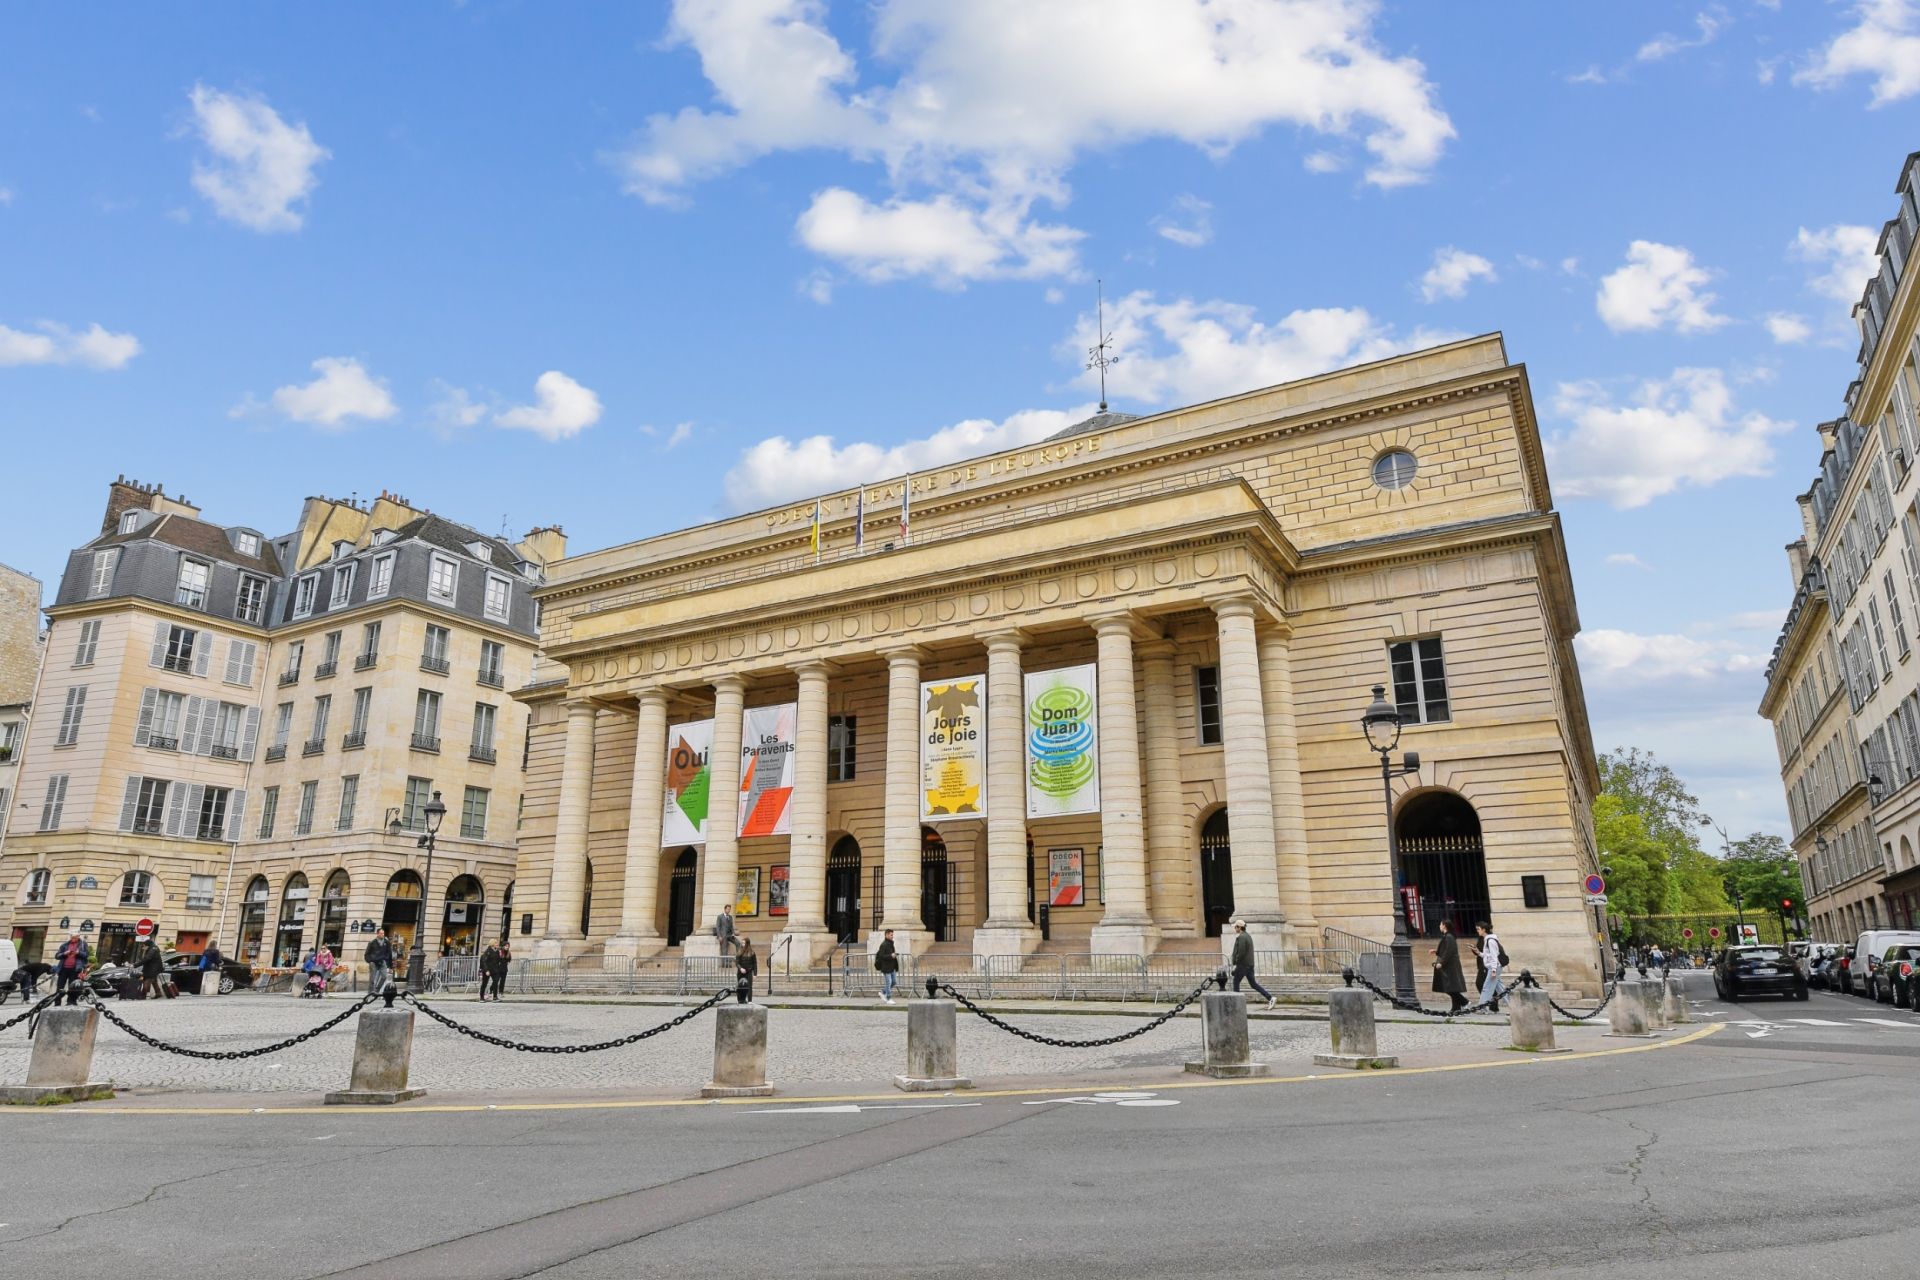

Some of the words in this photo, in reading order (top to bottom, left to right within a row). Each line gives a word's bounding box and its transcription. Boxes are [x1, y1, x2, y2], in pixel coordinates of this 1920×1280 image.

[766, 502, 831, 526] ODEON
[841, 476, 937, 510] THEATRE
[950, 467, 977, 485] DE
[990, 438, 1101, 476] L'EUROPE
[1042, 707, 1078, 722] Dom
[933, 716, 971, 730] Jours
[1042, 722, 1078, 736] Juan
[760, 733, 779, 744] Les
[928, 731, 945, 745] de
[949, 728, 977, 745] joie
[743, 742, 795, 757] Paravents
[674, 746, 709, 769] Oui
[1053, 852, 1079, 860] ODÉON
[1050, 869, 1082, 877] Paravents
